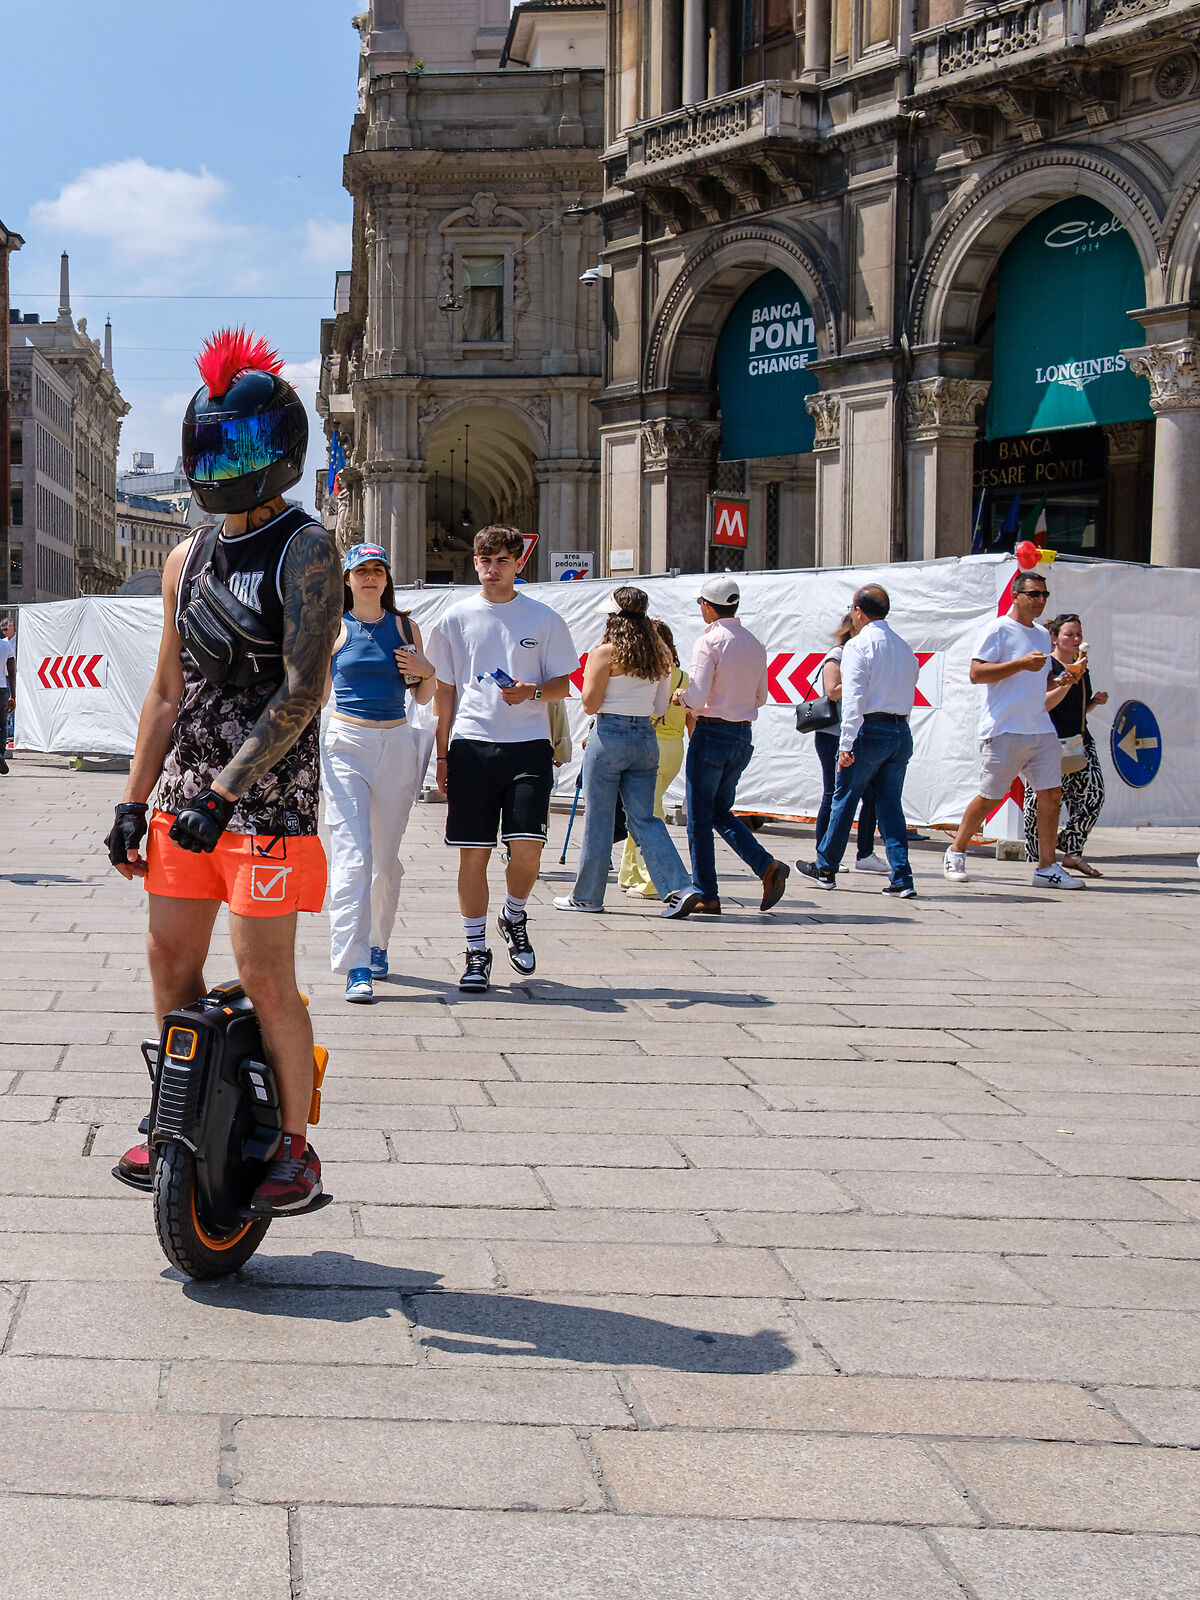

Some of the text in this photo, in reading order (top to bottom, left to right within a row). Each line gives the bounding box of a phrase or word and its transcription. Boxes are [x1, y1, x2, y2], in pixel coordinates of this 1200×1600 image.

[1044, 215, 1125, 248] Ciel
[1075, 241, 1099, 255] 1914
[751, 302, 801, 324] BANCA
[749, 317, 815, 353] PONT
[748, 353, 809, 376] CHANGE
[1035, 354, 1127, 384] LONGINES
[999, 438, 1052, 460] BANCA
[972, 459, 1083, 488] CESARE PONTI
[715, 509, 745, 538] M
[555, 560, 589, 568] pedonale
[229, 570, 265, 615] ORK
